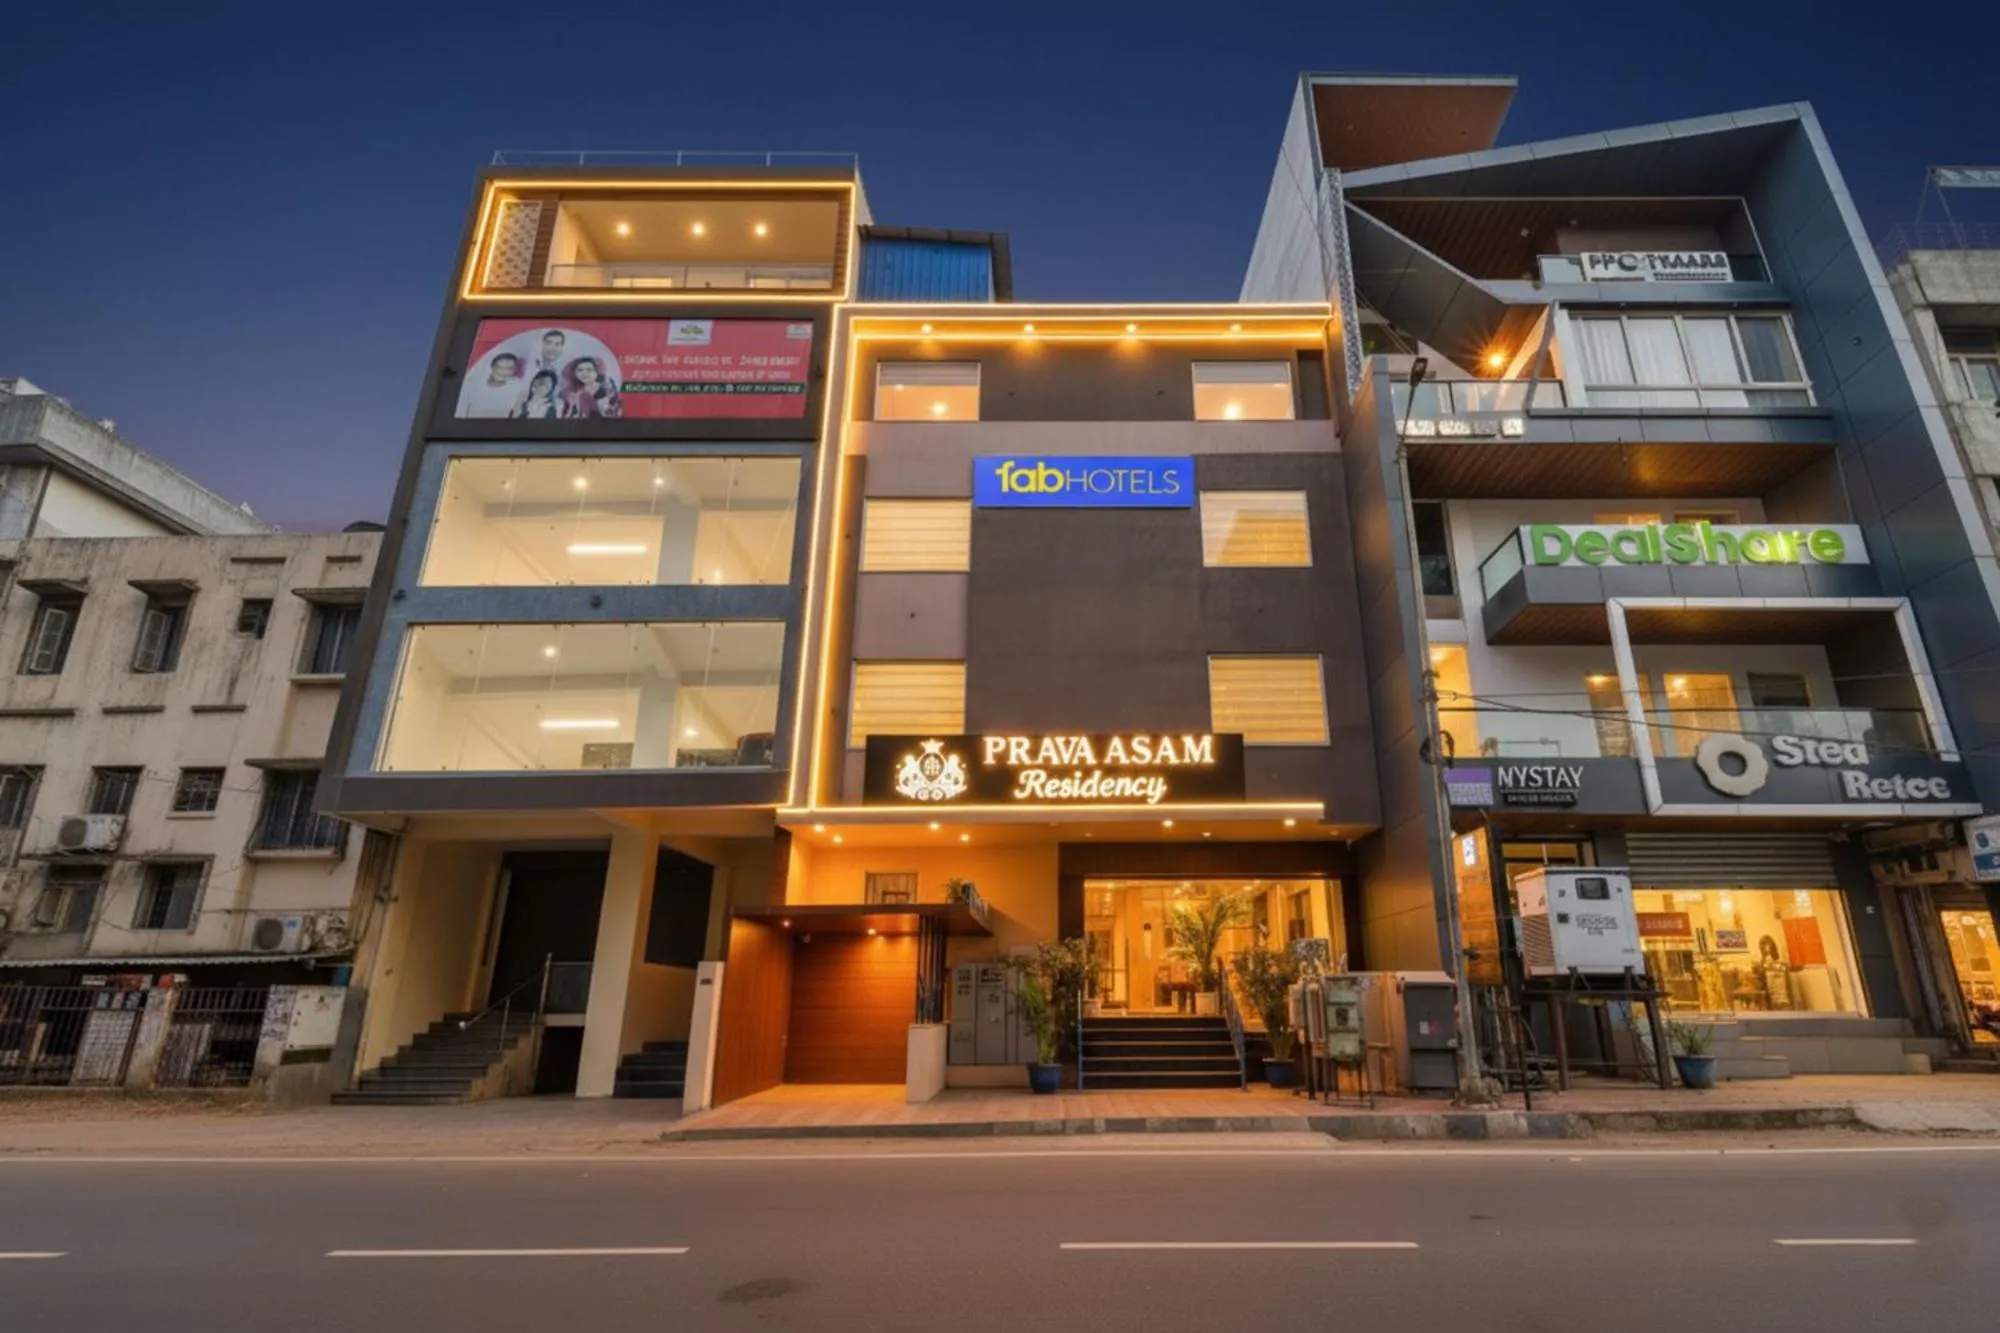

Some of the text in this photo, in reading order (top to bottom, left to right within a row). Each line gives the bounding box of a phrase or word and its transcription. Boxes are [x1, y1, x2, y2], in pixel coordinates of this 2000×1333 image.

[995, 460, 1181, 494] fabHOTELS
[1530, 520, 1846, 566] DealShare
[982, 734, 1214, 765] PRAVA ASAM
[1013, 769, 1168, 806] Residency
